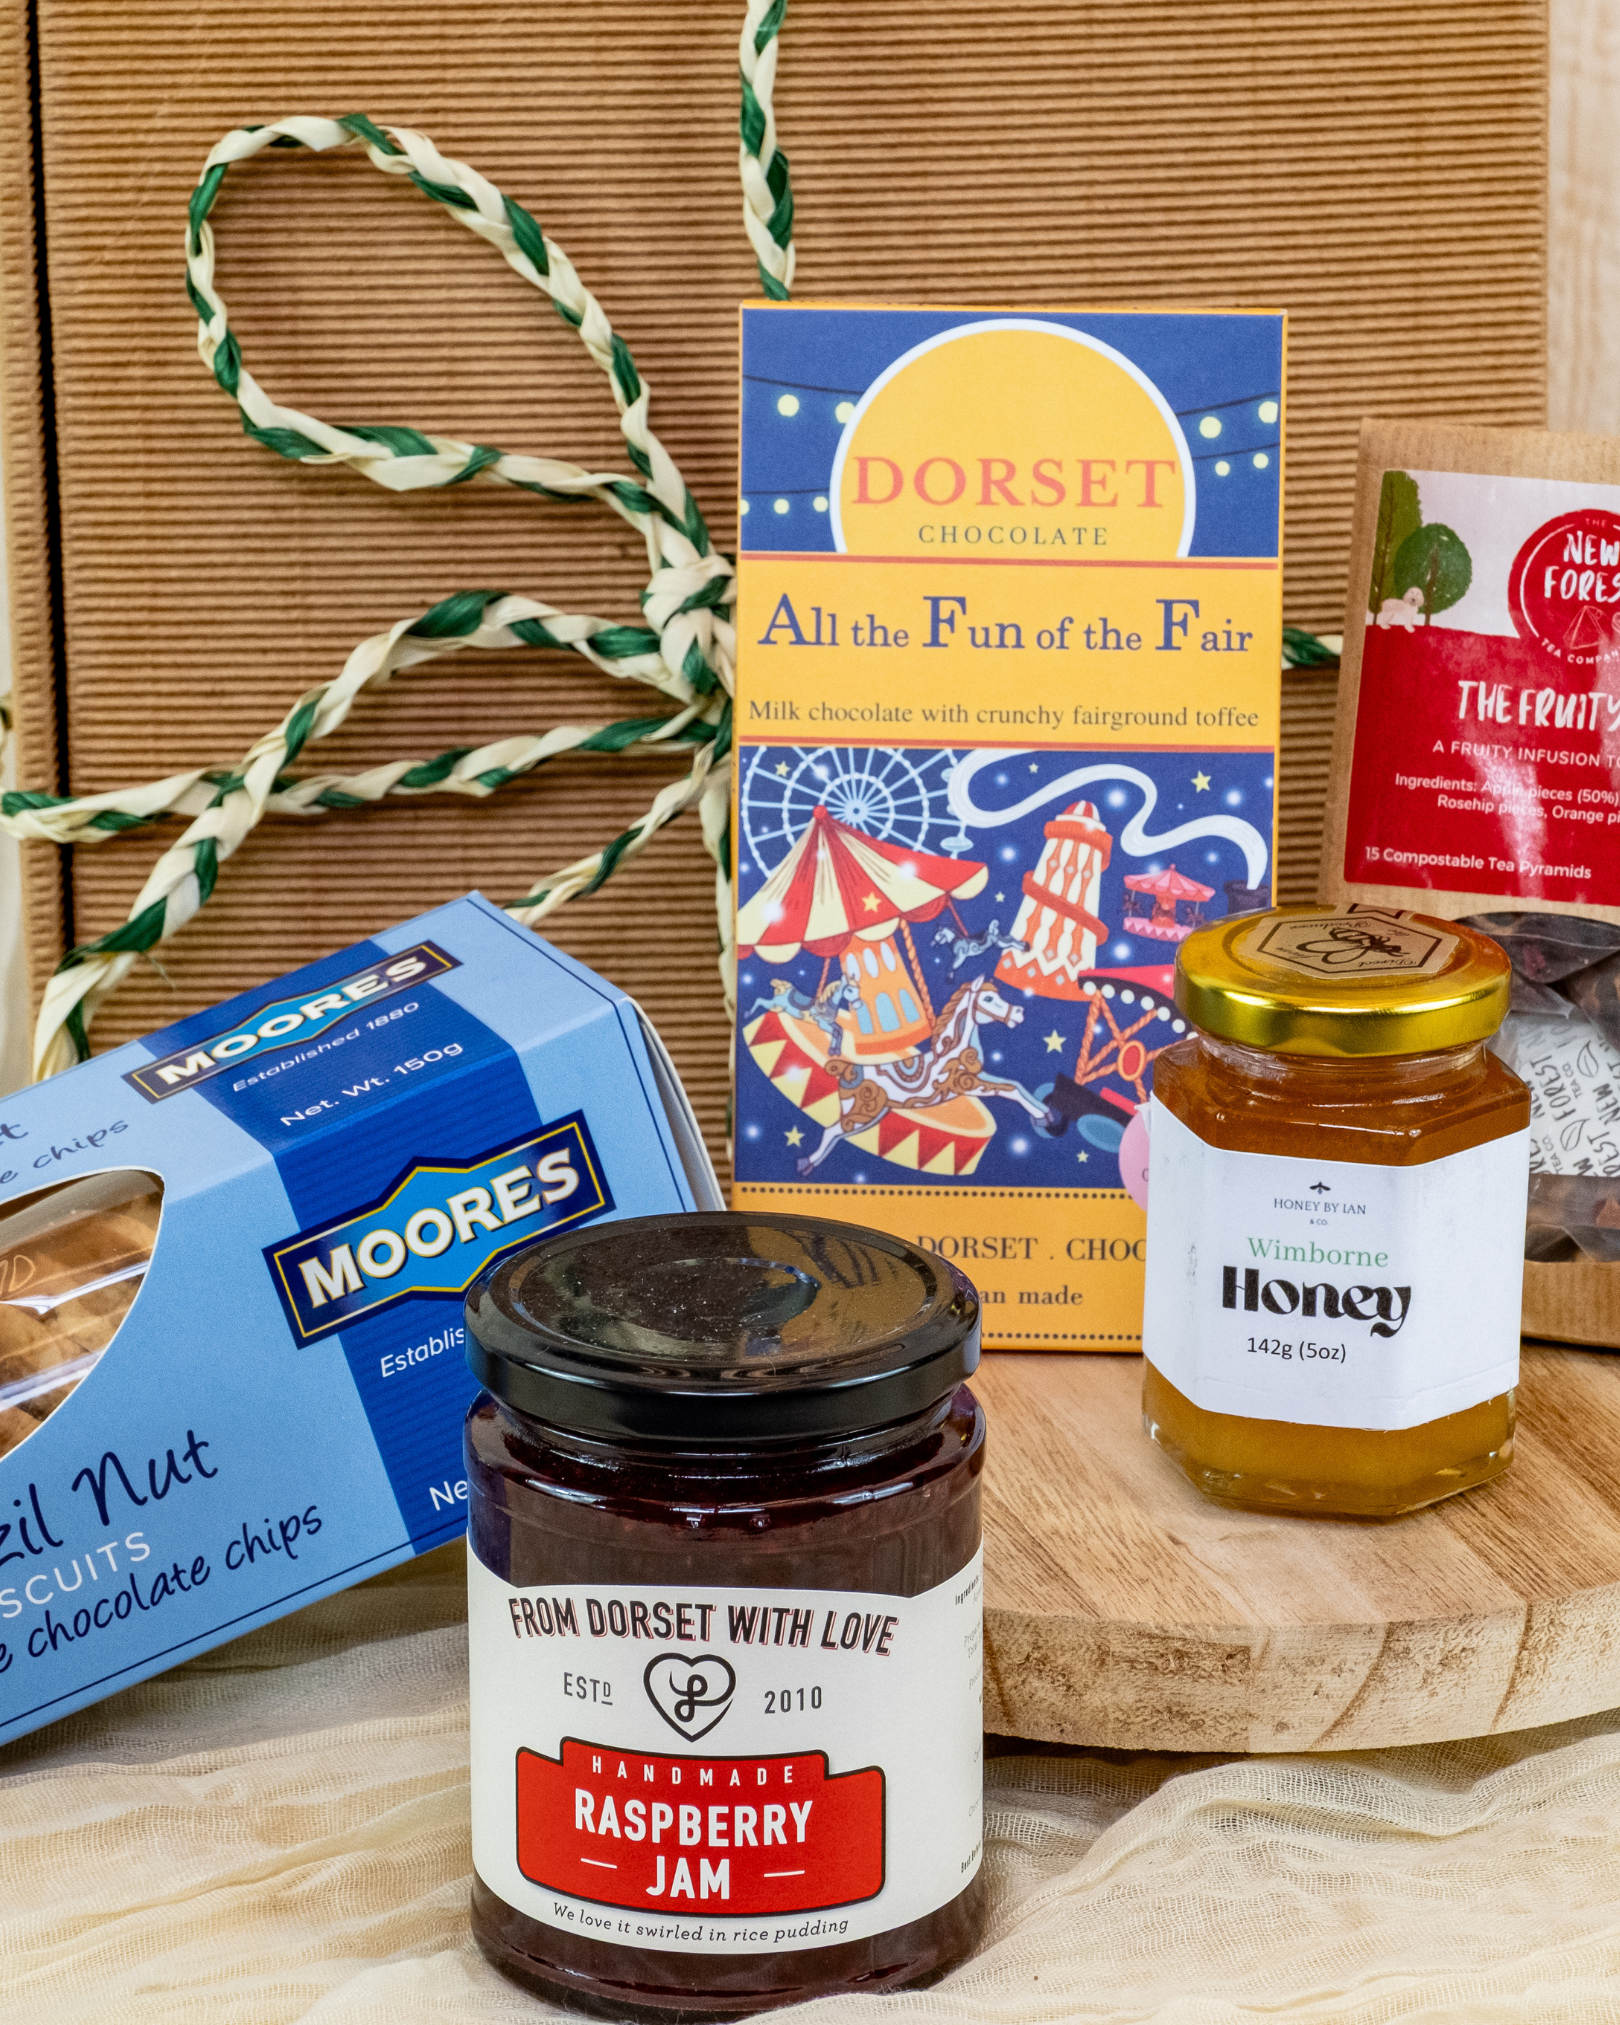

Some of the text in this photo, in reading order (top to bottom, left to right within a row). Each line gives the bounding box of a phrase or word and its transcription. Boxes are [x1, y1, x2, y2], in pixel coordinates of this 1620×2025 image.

[852, 456, 1176, 508] DORSET
[918, 525, 1107, 546] CHOCOLATE
[1585, 517, 1607, 528] THE
[1563, 530, 1620, 566] NEW
[757, 592, 1254, 652] All the Fun of the Fair
[1541, 637, 1562, 659] TEA
[749, 700, 1259, 731] Milk chocolate with crunchy fairground toffee
[1458, 680, 1620, 732] THE FRUITY
[1432, 740, 1445, 754] A
[1451, 741, 1513, 760] FRUITY
[1518, 747, 1600, 768] INFUSION
[1395, 773, 1477, 793] Ingredients:
[1527, 784, 1573, 801] pieces
[1437, 794, 1495, 814] Rosehip
[1498, 802, 1548, 819] pieces,
[1552, 805, 1604, 825] Orange
[1365, 846, 1592, 879] 15 Compostable Tea Pyramids
[154, 956, 428, 1087] MOORES
[232, 1002, 419, 1092] Established 1880
[280, 1042, 464, 1127] Net. Wt. 150g
[1530, 1055, 1577, 1122] FOREST
[32, 1120, 129, 1169] chips
[1273, 1198, 1367, 1215] HONEY BY IAN
[298, 1147, 581, 1310] MOORES
[917, 1235, 1039, 1260] DORSET
[1247, 1236, 1389, 1268] Wimborne
[1018, 1284, 1084, 1306] made
[1222, 1265, 1412, 1339] Honey
[1246, 1337, 1347, 1364] 142g (5oz)
[71, 1428, 219, 1527] Nut
[0, 1531, 151, 1619] SCUITS
[28, 1505, 323, 1659] chocolate chips
[508, 1597, 900, 1657] FROM DORSET WITH LOVE
[764, 1685, 822, 1714] 2010
[592, 1755, 794, 1787] HANDMADE
[575, 1787, 813, 1848] RASPBERRY
[645, 1855, 730, 1900] JAM
[553, 1902, 849, 1943] We love it swirled in rice pudding
